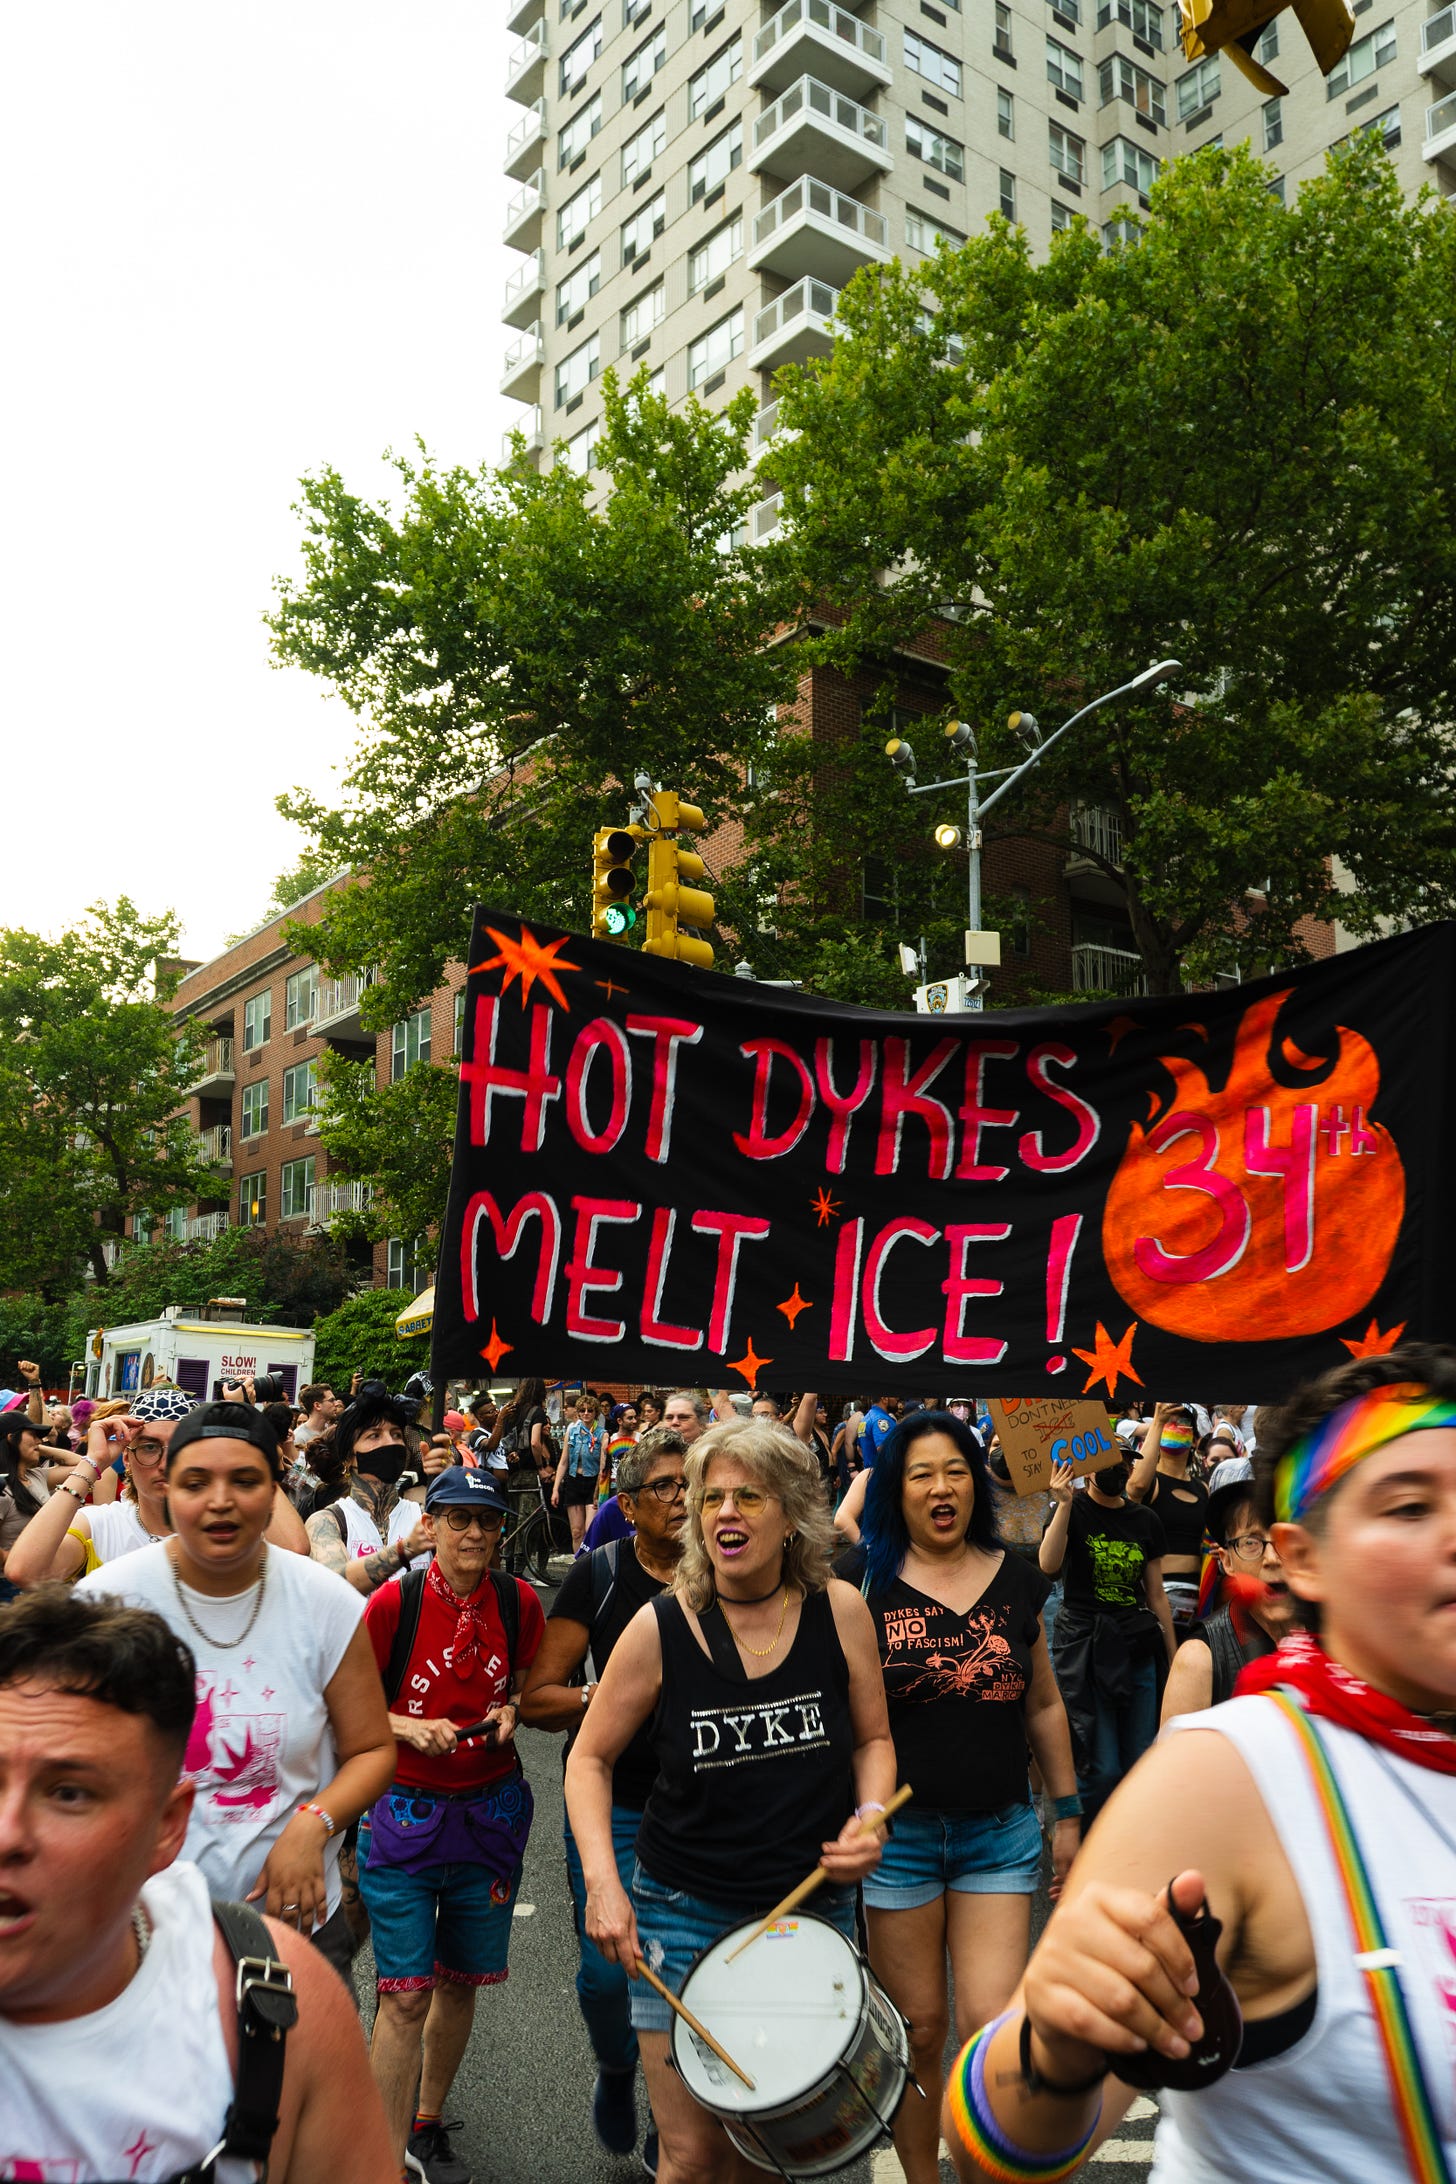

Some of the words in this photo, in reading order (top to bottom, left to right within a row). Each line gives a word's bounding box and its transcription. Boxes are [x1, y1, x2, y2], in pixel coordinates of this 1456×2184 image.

[460, 995, 704, 1164] HOT
[732, 1037, 1101, 1182] DYKES
[1134, 1103, 1377, 1283] 34th
[460, 1190, 771, 1356] MELT
[828, 1216, 1013, 1364] ICE
[221, 1355, 257, 1368] SLOW!
[220, 1368, 256, 1376] CHILDREN
[1021, 1448, 1038, 1461] TO
[1050, 1427, 1113, 1468] COOL
[1022, 1461, 1043, 1478] STAY
[883, 1608, 920, 1622] DYKES
[924, 1606, 944, 1617] SAY
[886, 1618, 926, 1642] NO
[887, 1642, 902, 1650] TO
[907, 1633, 964, 1650] FASCISM!
[982, 1690, 1020, 1700] MARC
[690, 1703, 825, 1757] DYKE
